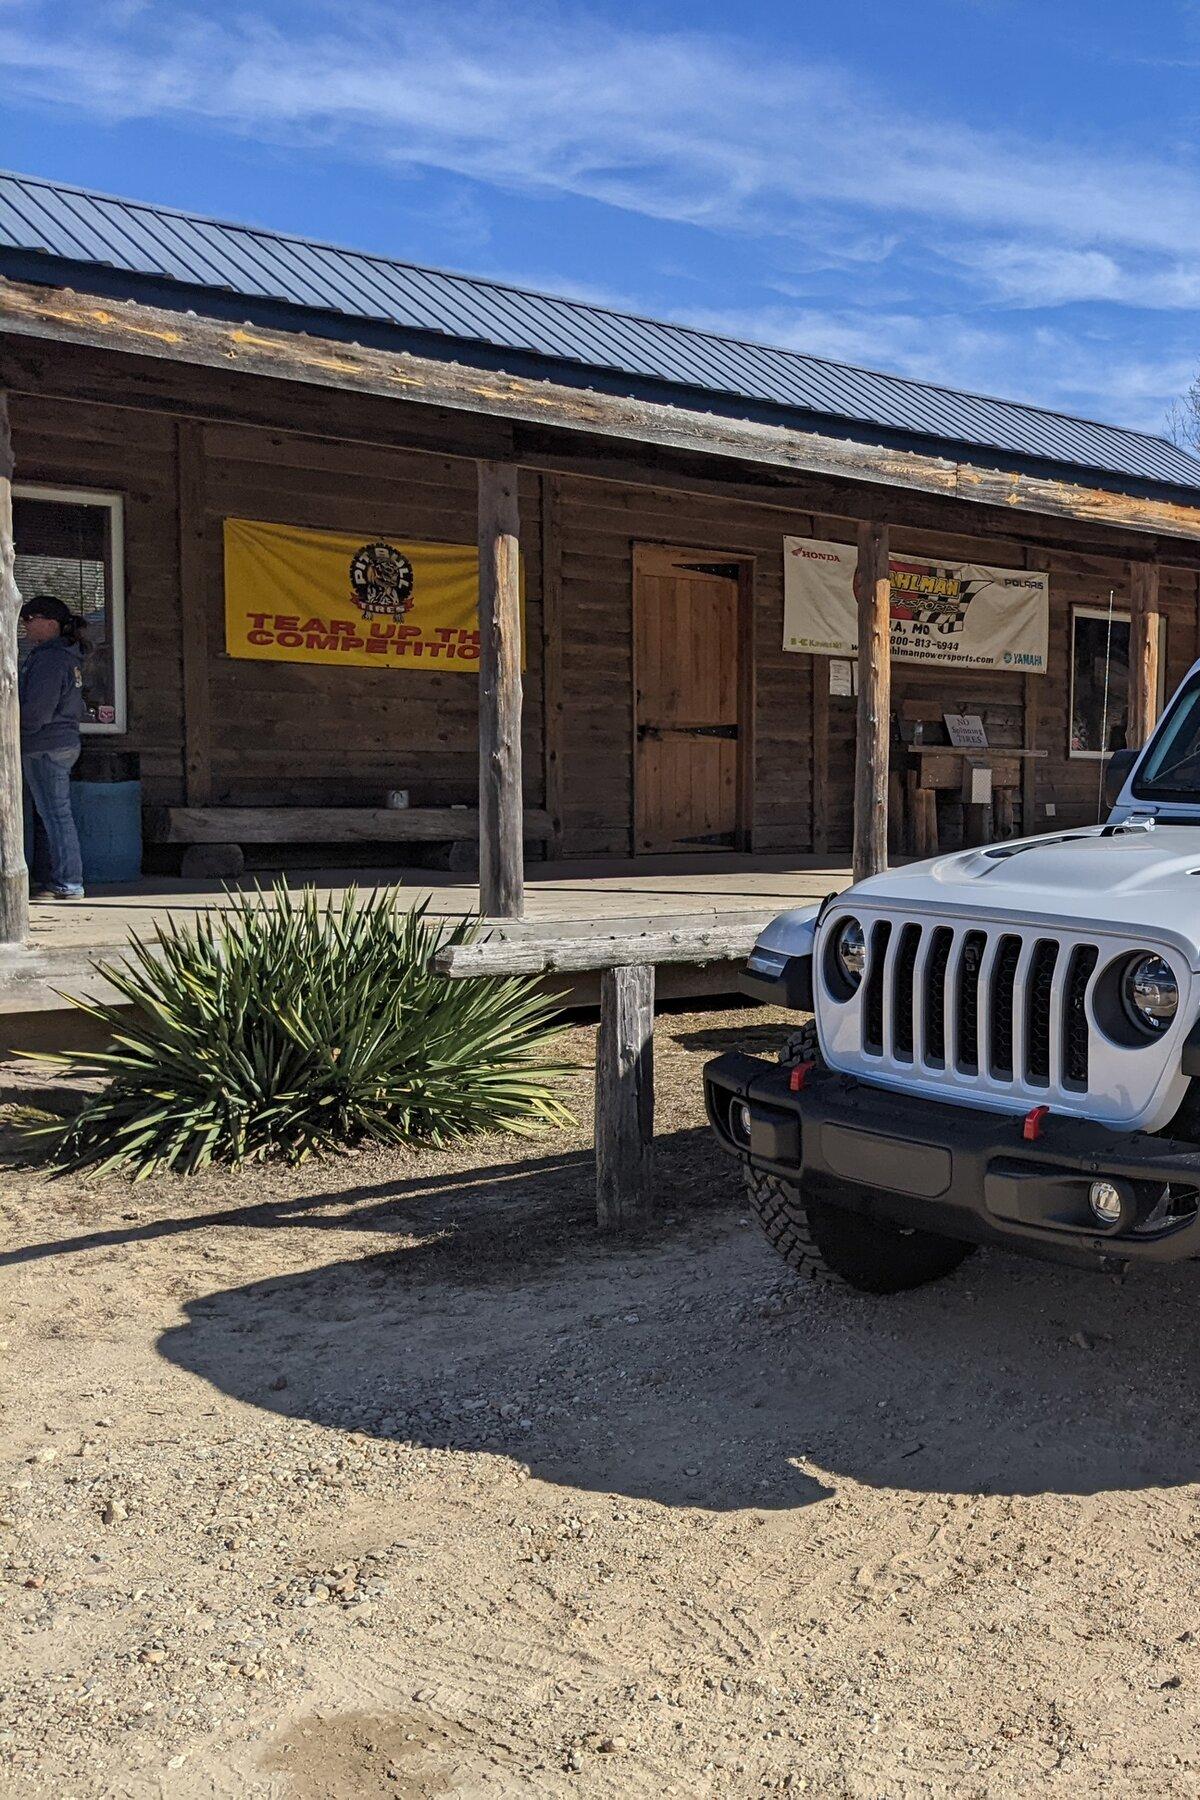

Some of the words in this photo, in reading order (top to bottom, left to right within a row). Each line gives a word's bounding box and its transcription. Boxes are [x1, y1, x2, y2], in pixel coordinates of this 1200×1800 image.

[802, 549, 840, 562] HONDA
[353, 551, 370, 585] PIT
[374, 547, 410, 589] BULL
[1004, 578, 1044, 590] POLARIS
[361, 603, 406, 614] TIRES
[246, 613, 357, 637] TEAR
[370, 623, 423, 640] UP
[435, 628, 480, 645] TH
[912, 624, 930, 636] MO
[246, 630, 480, 660] COMPETITIO
[1012, 652, 1043, 666] YAMAHA
